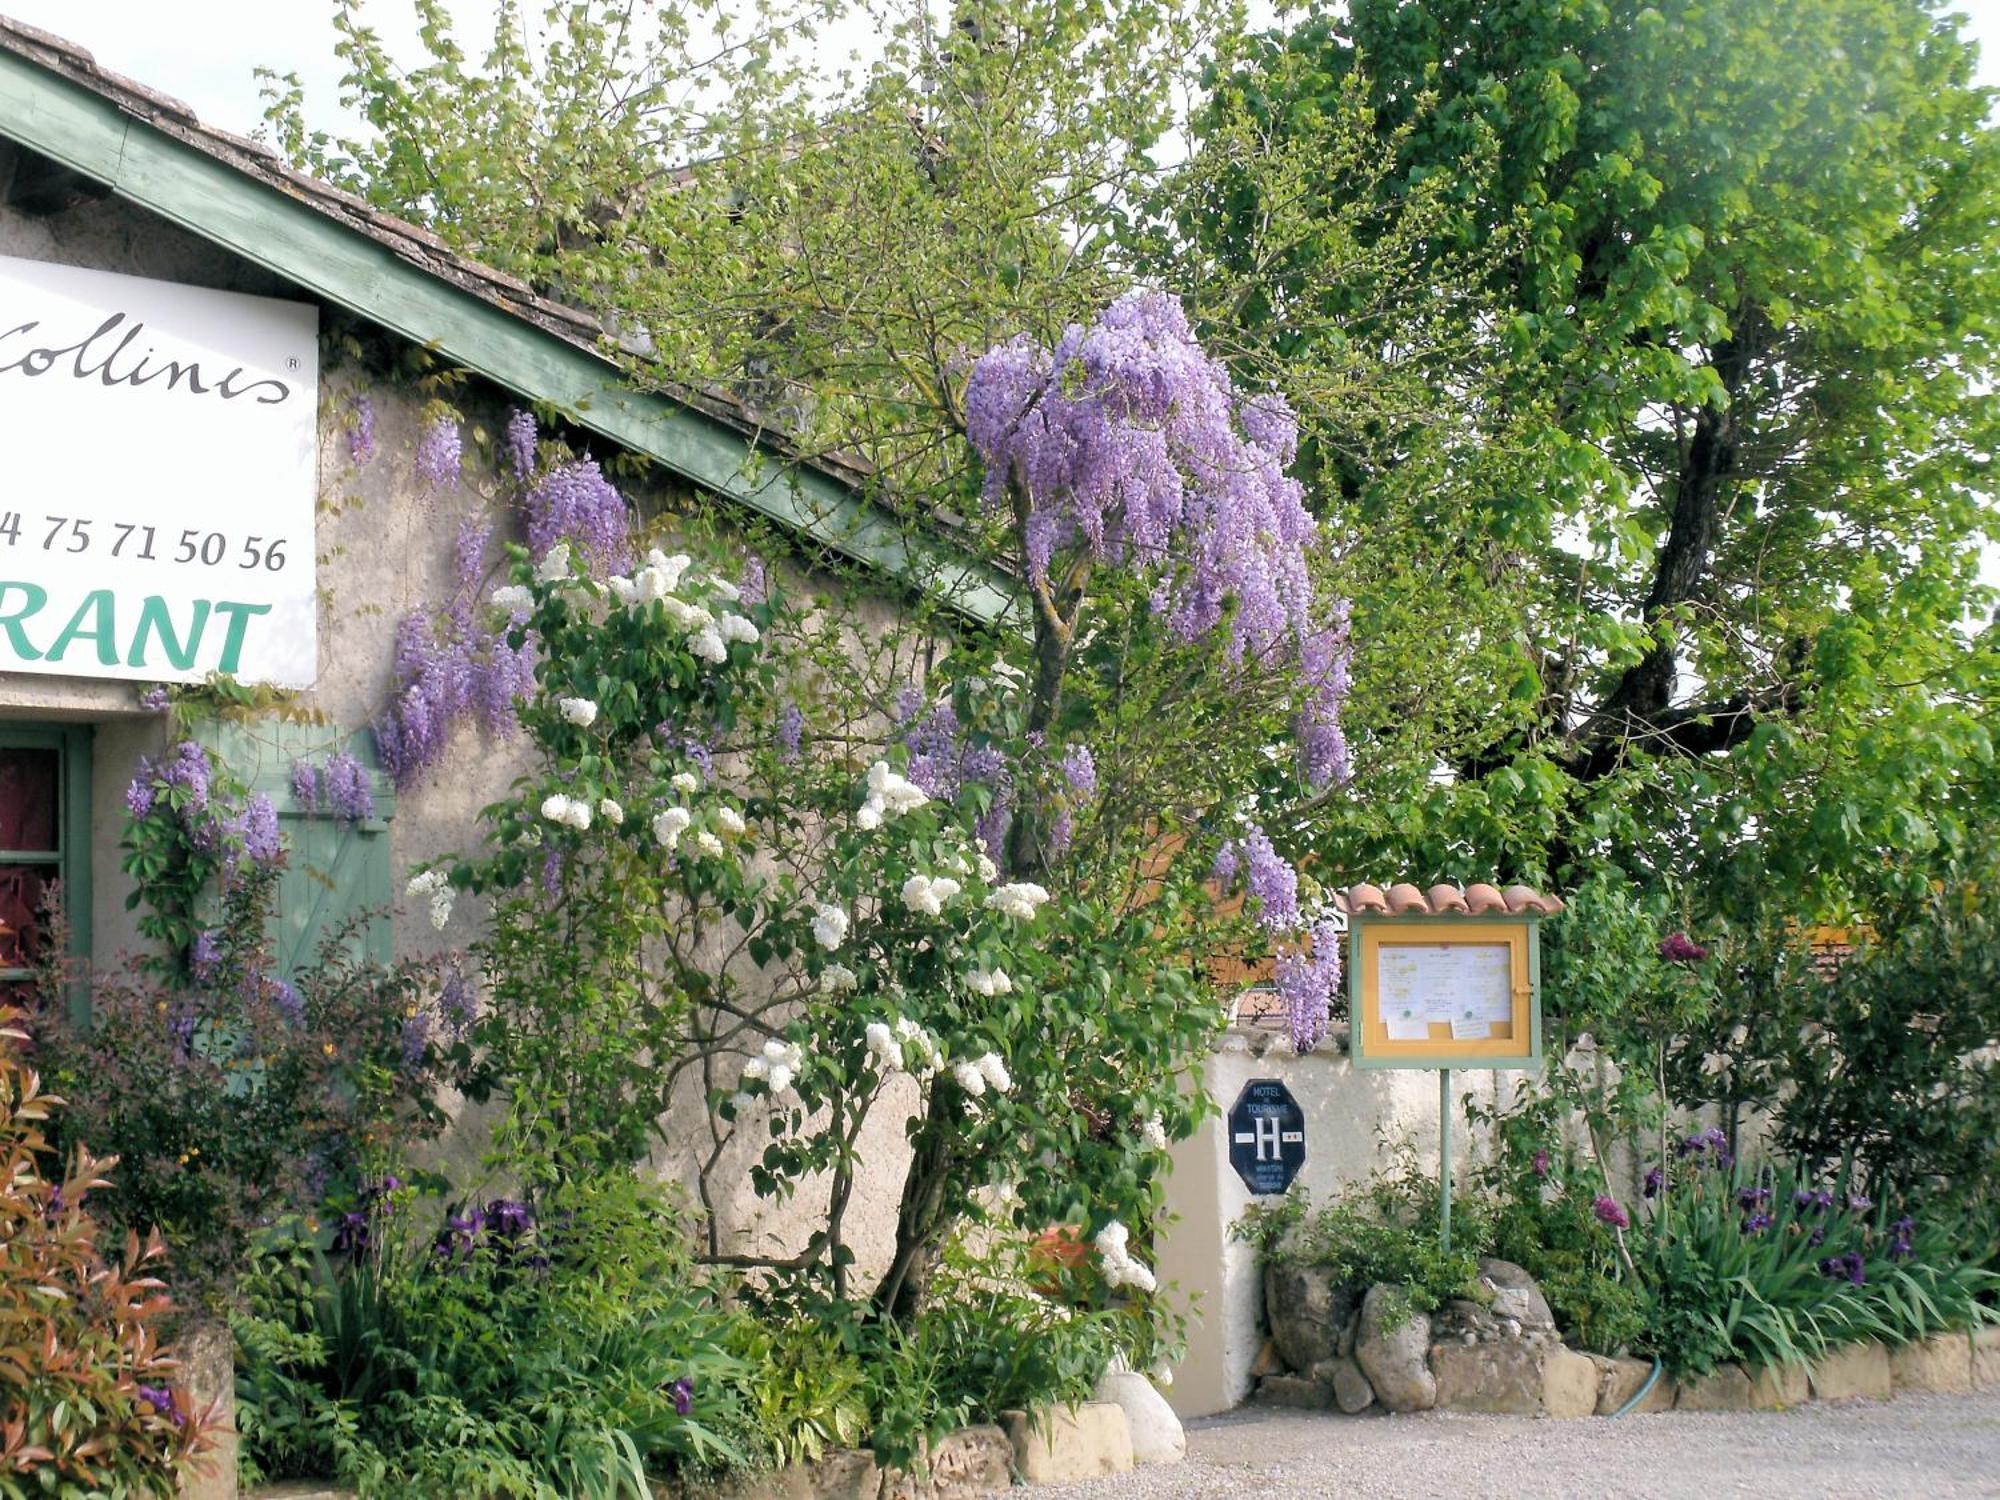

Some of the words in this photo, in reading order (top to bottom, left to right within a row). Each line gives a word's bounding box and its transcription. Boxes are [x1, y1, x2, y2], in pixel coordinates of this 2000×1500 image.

[0, 511, 22, 546] 4
[43, 515, 93, 553] 75
[111, 522, 156, 560] 71
[174, 529, 226, 566] 50
[238, 535, 287, 572] 56
[0, 581, 273, 674] RANT
[1255, 1116, 1282, 1161] H
